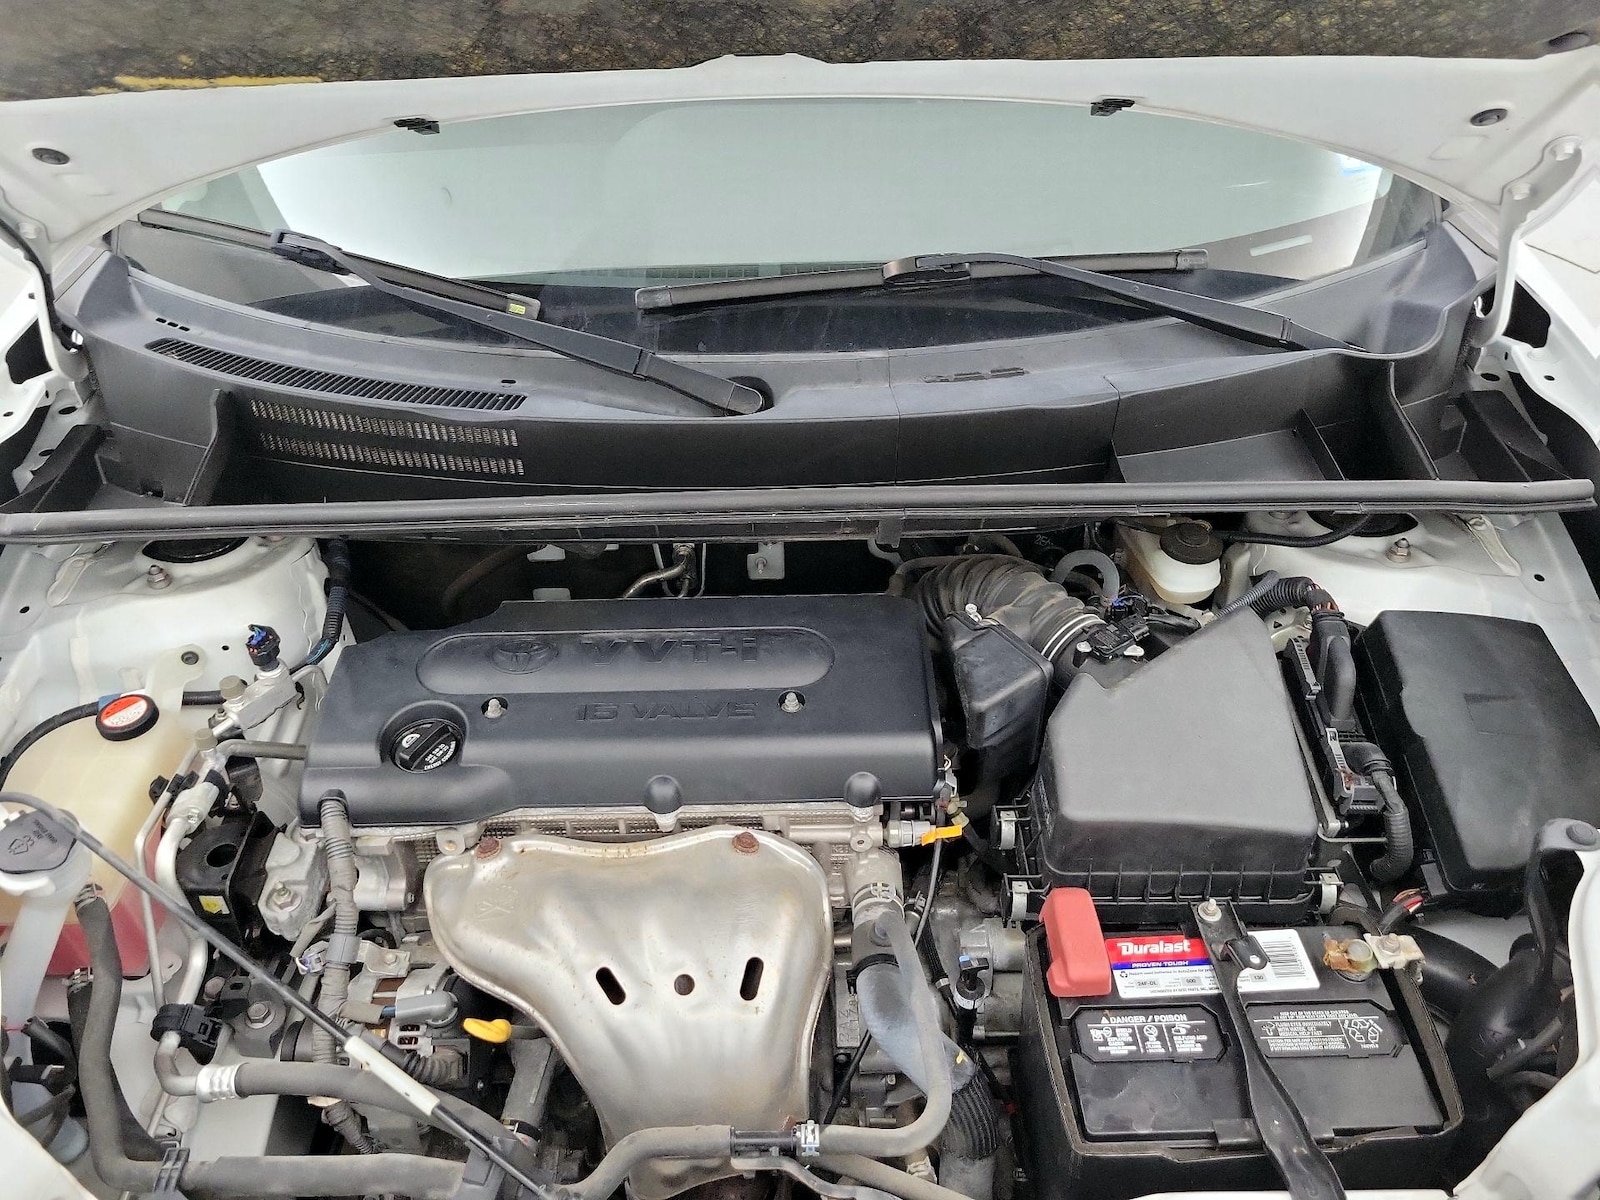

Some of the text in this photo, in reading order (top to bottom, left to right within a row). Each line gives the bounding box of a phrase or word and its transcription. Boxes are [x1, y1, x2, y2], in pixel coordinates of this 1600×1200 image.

[576, 701, 757, 721] 16 VALVE
[1117, 938, 1191, 956] Duralast
[1131, 961, 1165, 969] PROVEN
[1110, 1014, 1146, 1024] DANGER
[1154, 1013, 1188, 1023] POISON
